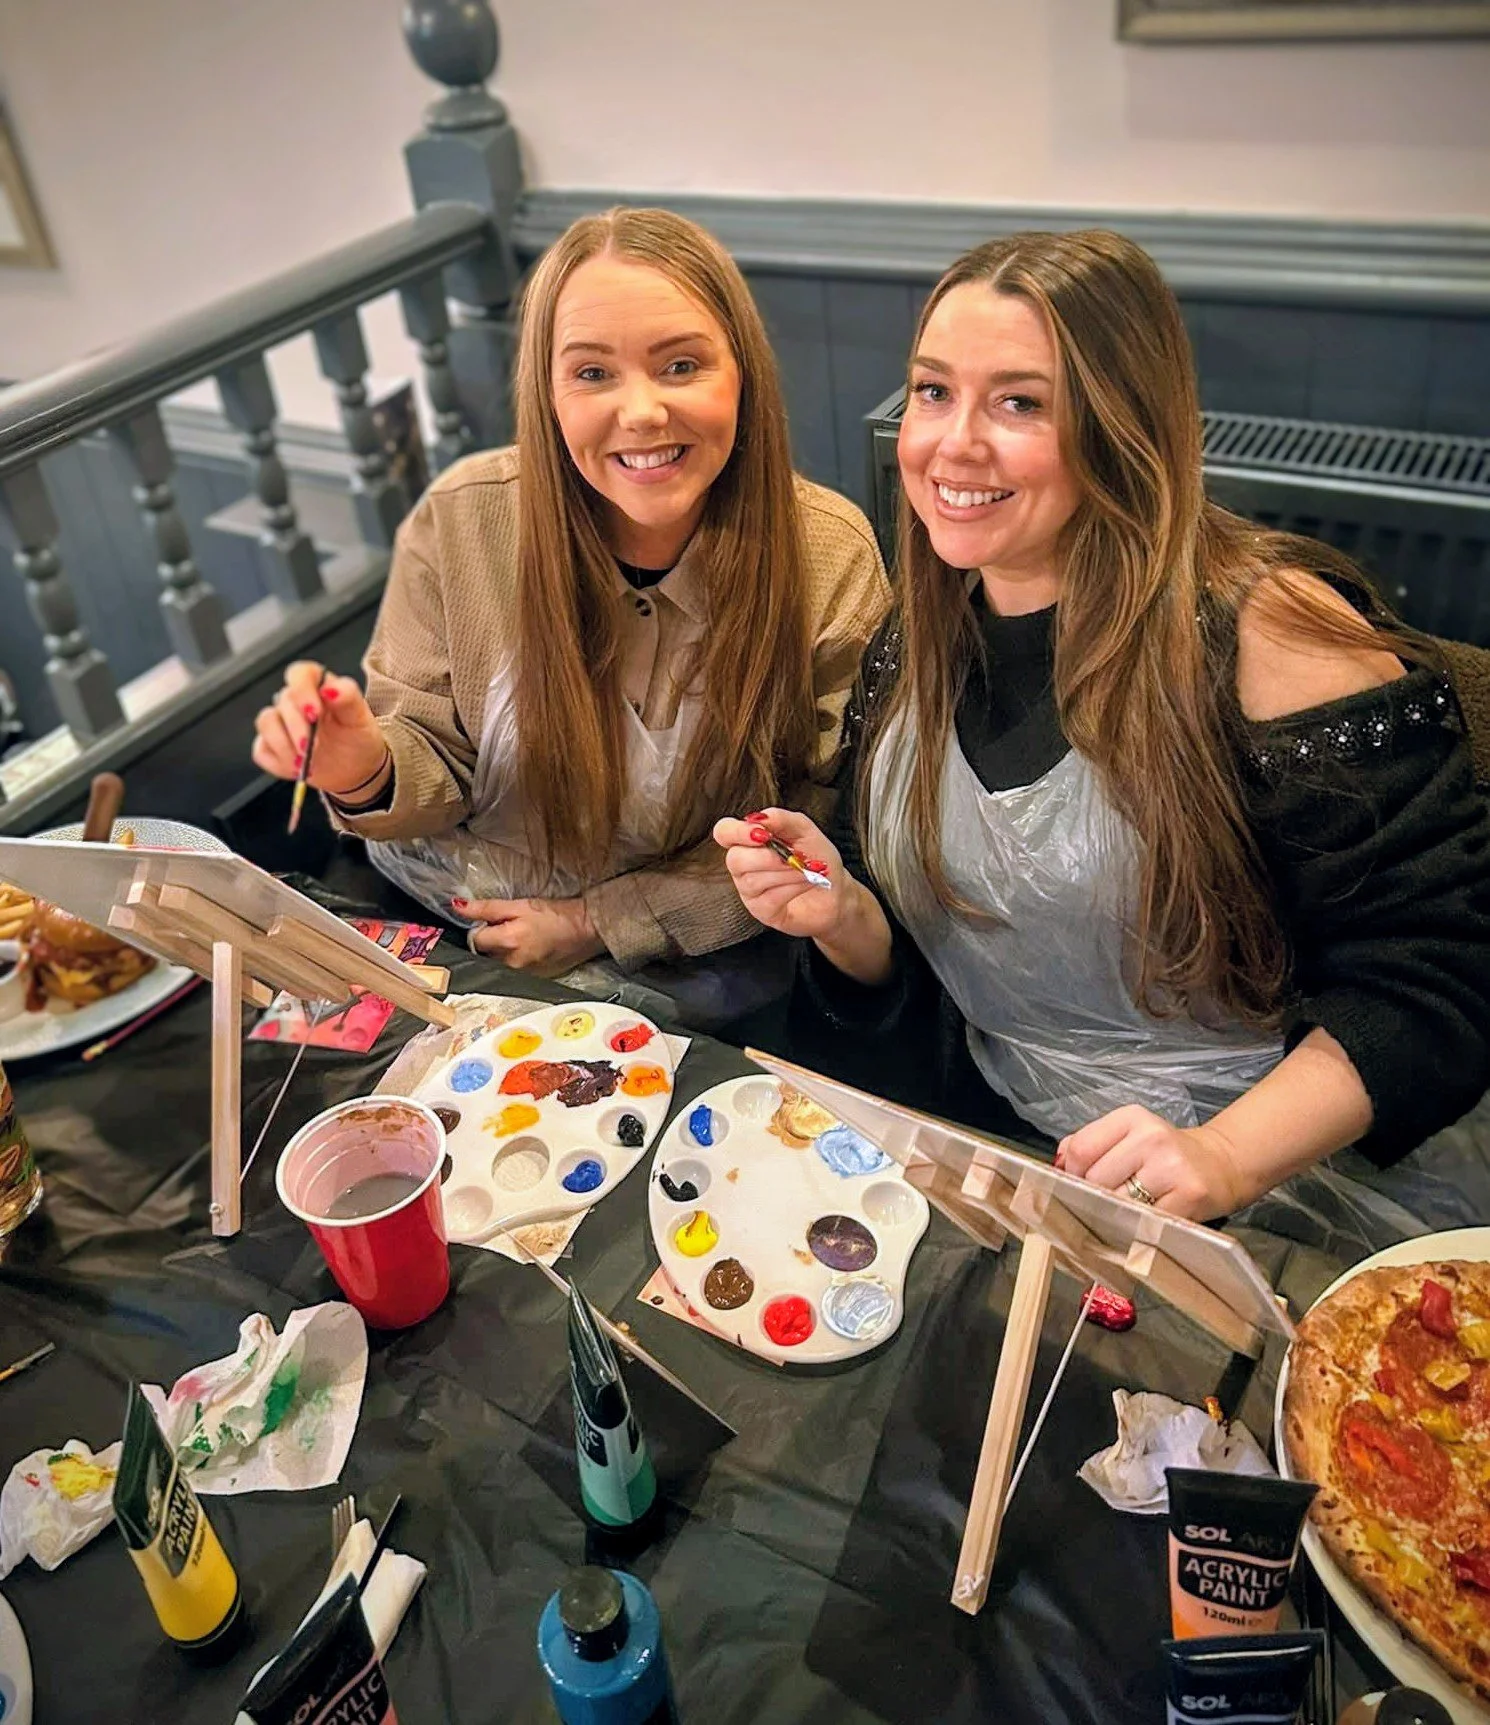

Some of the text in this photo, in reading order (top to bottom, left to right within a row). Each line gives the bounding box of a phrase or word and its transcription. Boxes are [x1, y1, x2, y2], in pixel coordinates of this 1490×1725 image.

[1184, 1524, 1233, 1544] SOL
[1184, 1557, 1287, 1589] ACRYLIC
[1198, 1578, 1272, 1607] PAINT
[1203, 1607, 1246, 1626] 120ml
[1181, 1694, 1233, 1712] SOL
